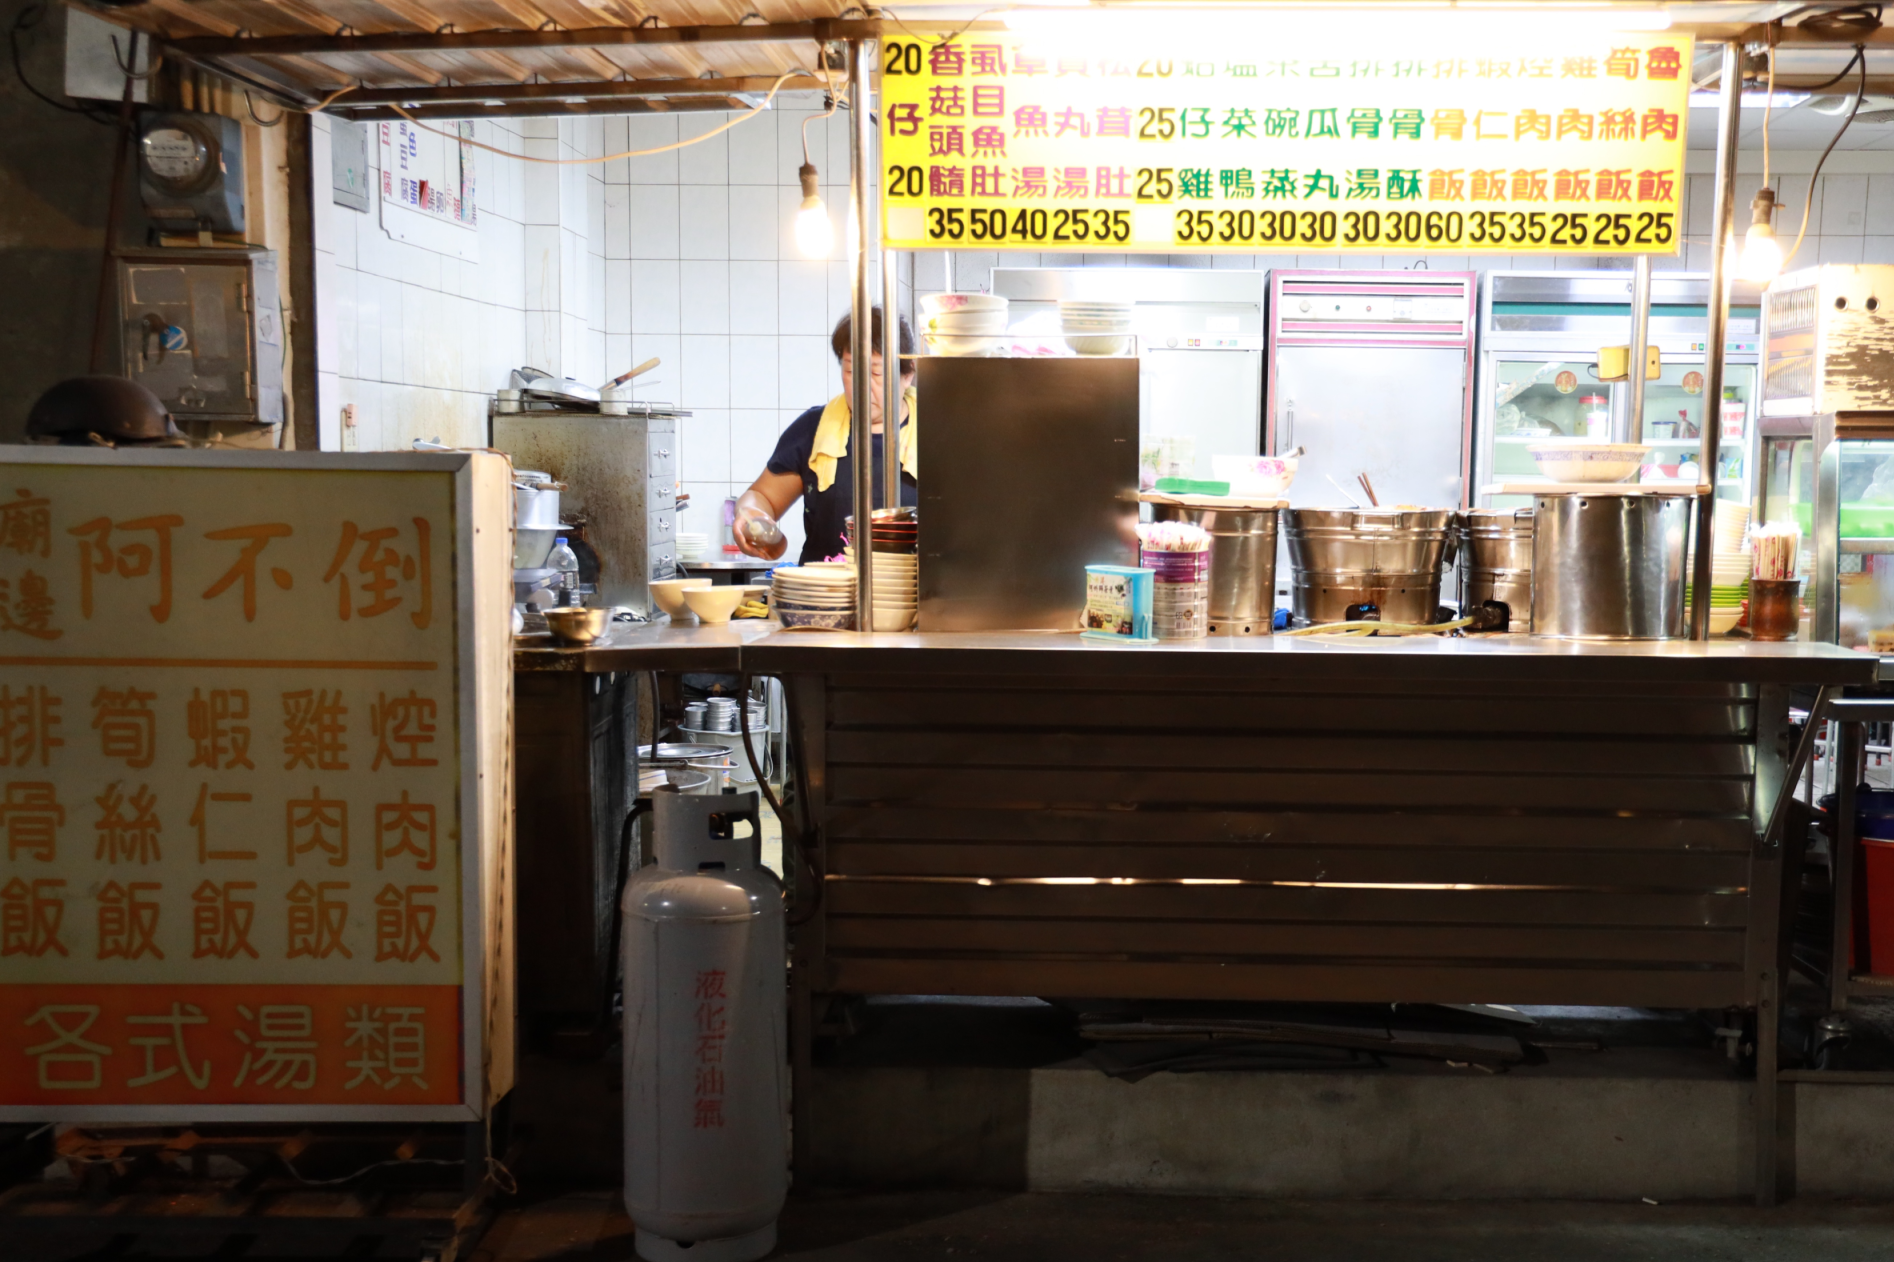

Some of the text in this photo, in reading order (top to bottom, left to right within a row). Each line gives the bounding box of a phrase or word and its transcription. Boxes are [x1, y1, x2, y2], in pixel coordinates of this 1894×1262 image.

[885, 42, 924, 198] 20 仔 20
[1139, 107, 1175, 140] 25
[970, 43, 1007, 241] 虱目魚肚 50
[1137, 167, 1173, 199] 25
[928, 207, 964, 240] 35
[1011, 208, 1047, 241] 40
[1053, 209, 1089, 241] 25
[1094, 209, 1130, 242] 35
[1177, 210, 1213, 242] 35
[1218, 210, 1254, 242] 30
[1259, 210, 1295, 242] 30
[1300, 210, 1336, 243] 30
[1343, 210, 1380, 243] 30
[1385, 210, 1421, 243] 30
[1425, 210, 1463, 243] 60
[1469, 211, 1506, 244] 35
[1509, 211, 1546, 244] 35
[1550, 212, 1588, 245] 25
[1593, 212, 1631, 246] 25
[1635, 211, 1673, 245] 25
[67, 513, 433, 630] 阿不倒
[0, 685, 69, 959] 排骨飯
[90, 685, 165, 961] 筍絲飯
[187, 687, 260, 961] 蝦仁飯
[281, 688, 353, 961] 雞肉飯
[23, 1001, 429, 1091] 各式湯類
[693, 969, 727, 1129] 液化石油氣
